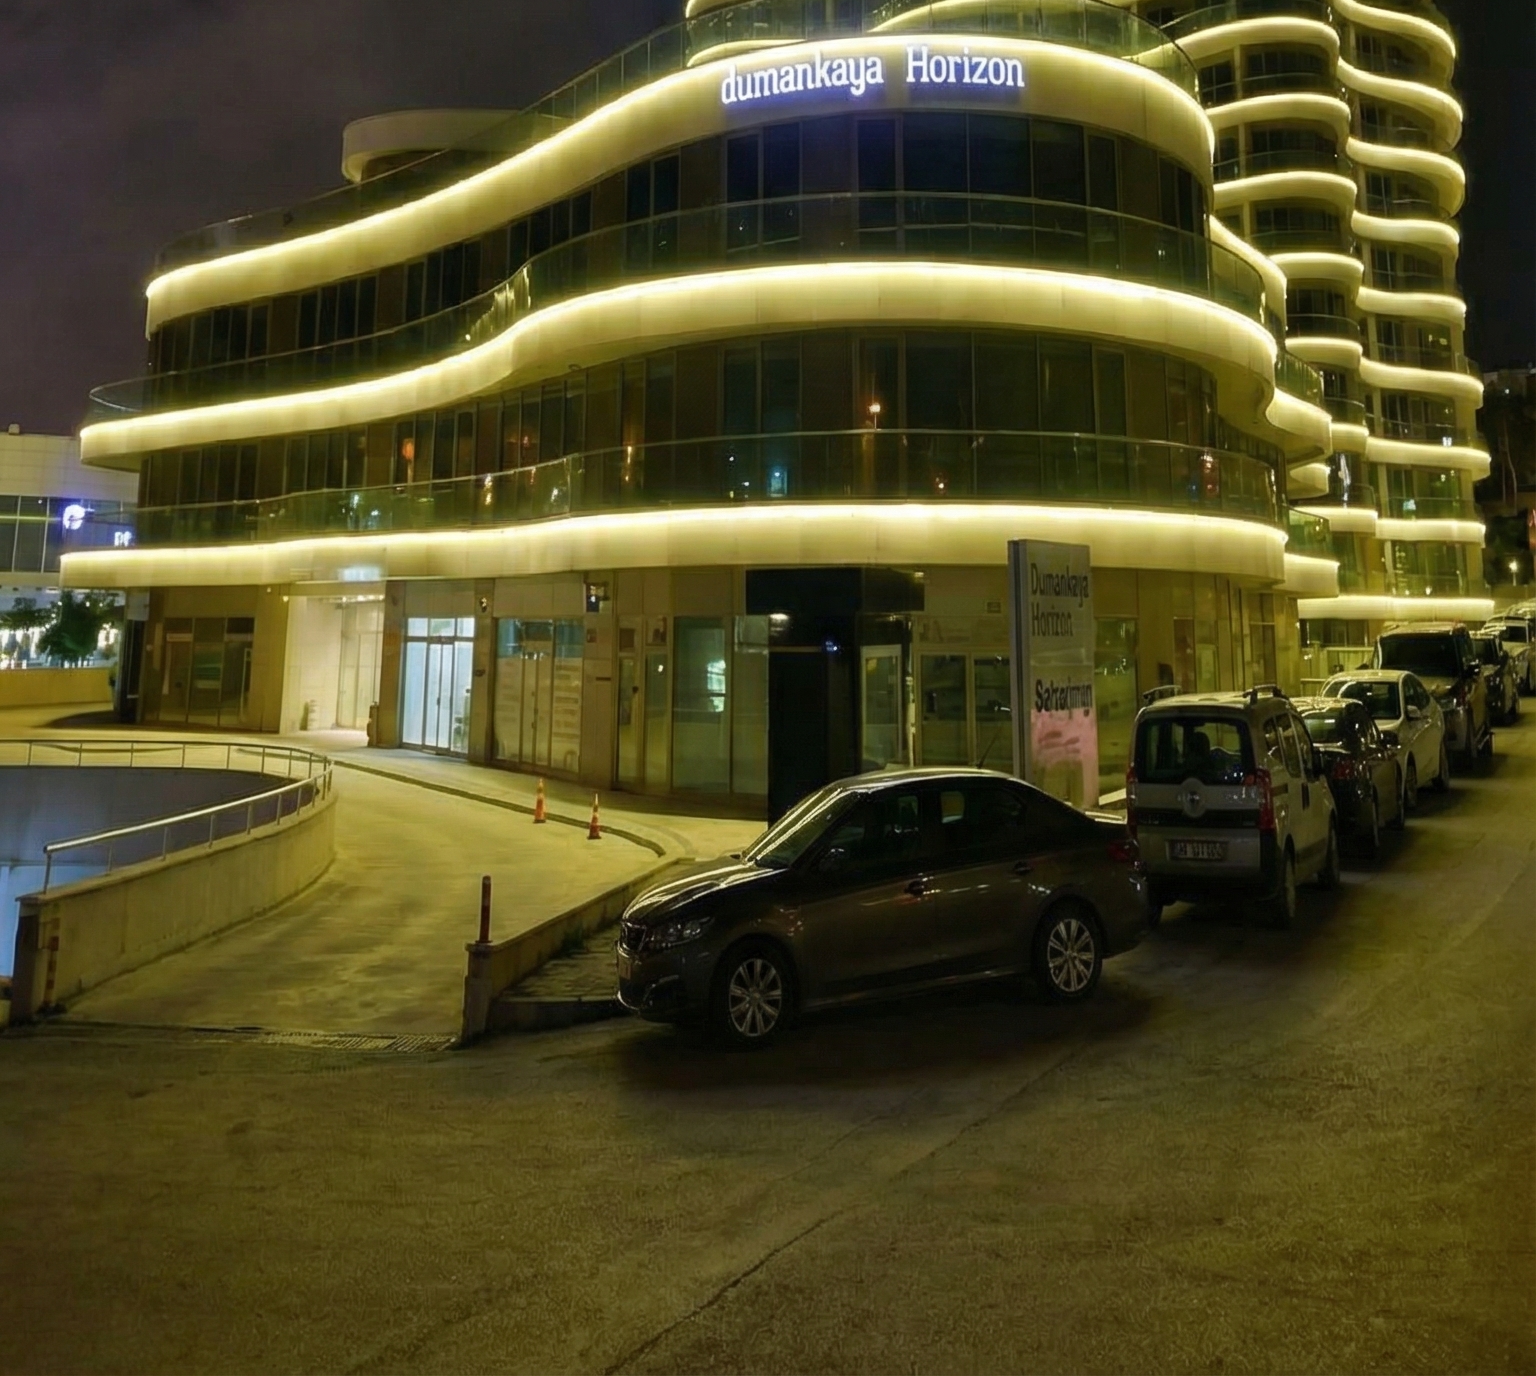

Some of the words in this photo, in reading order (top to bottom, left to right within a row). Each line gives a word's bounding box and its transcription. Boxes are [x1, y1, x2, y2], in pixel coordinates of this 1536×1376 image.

[721, 49, 884, 105] dumankaya
[906, 44, 1025, 88] Horizon
[1031, 601, 1074, 637] Horizon
